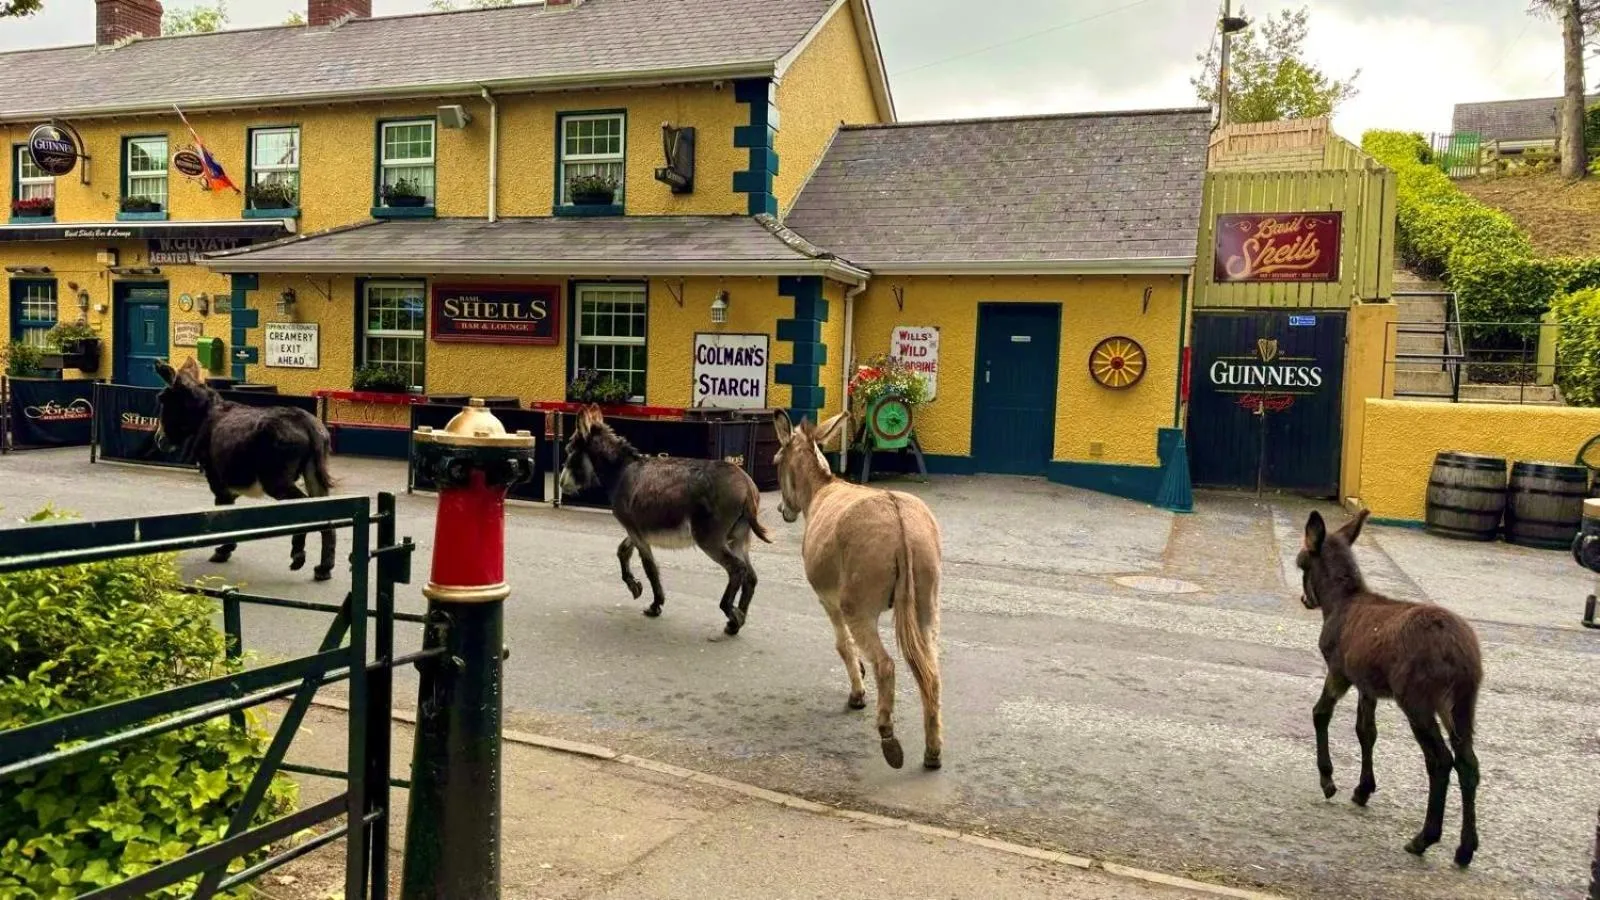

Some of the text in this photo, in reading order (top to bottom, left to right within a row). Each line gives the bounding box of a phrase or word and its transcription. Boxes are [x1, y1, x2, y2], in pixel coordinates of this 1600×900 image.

[34, 139, 73, 152] GUINNE
[1253, 216, 1304, 240] Basil
[150, 251, 188, 264] AERATED
[1226, 232, 1320, 278] Sheils
[443, 298, 547, 320] SHEILS
[462, 322, 529, 331] BAR & LOUNGE
[269, 332, 314, 342] CREAMERY
[280, 344, 301, 353] EXIT
[278, 356, 305, 366] AHEAD
[697, 344, 765, 367] COLMAN'S
[1209, 360, 1323, 387] GUINNESS
[699, 373, 760, 397] STARCH
[122, 412, 158, 425] SHEIL
